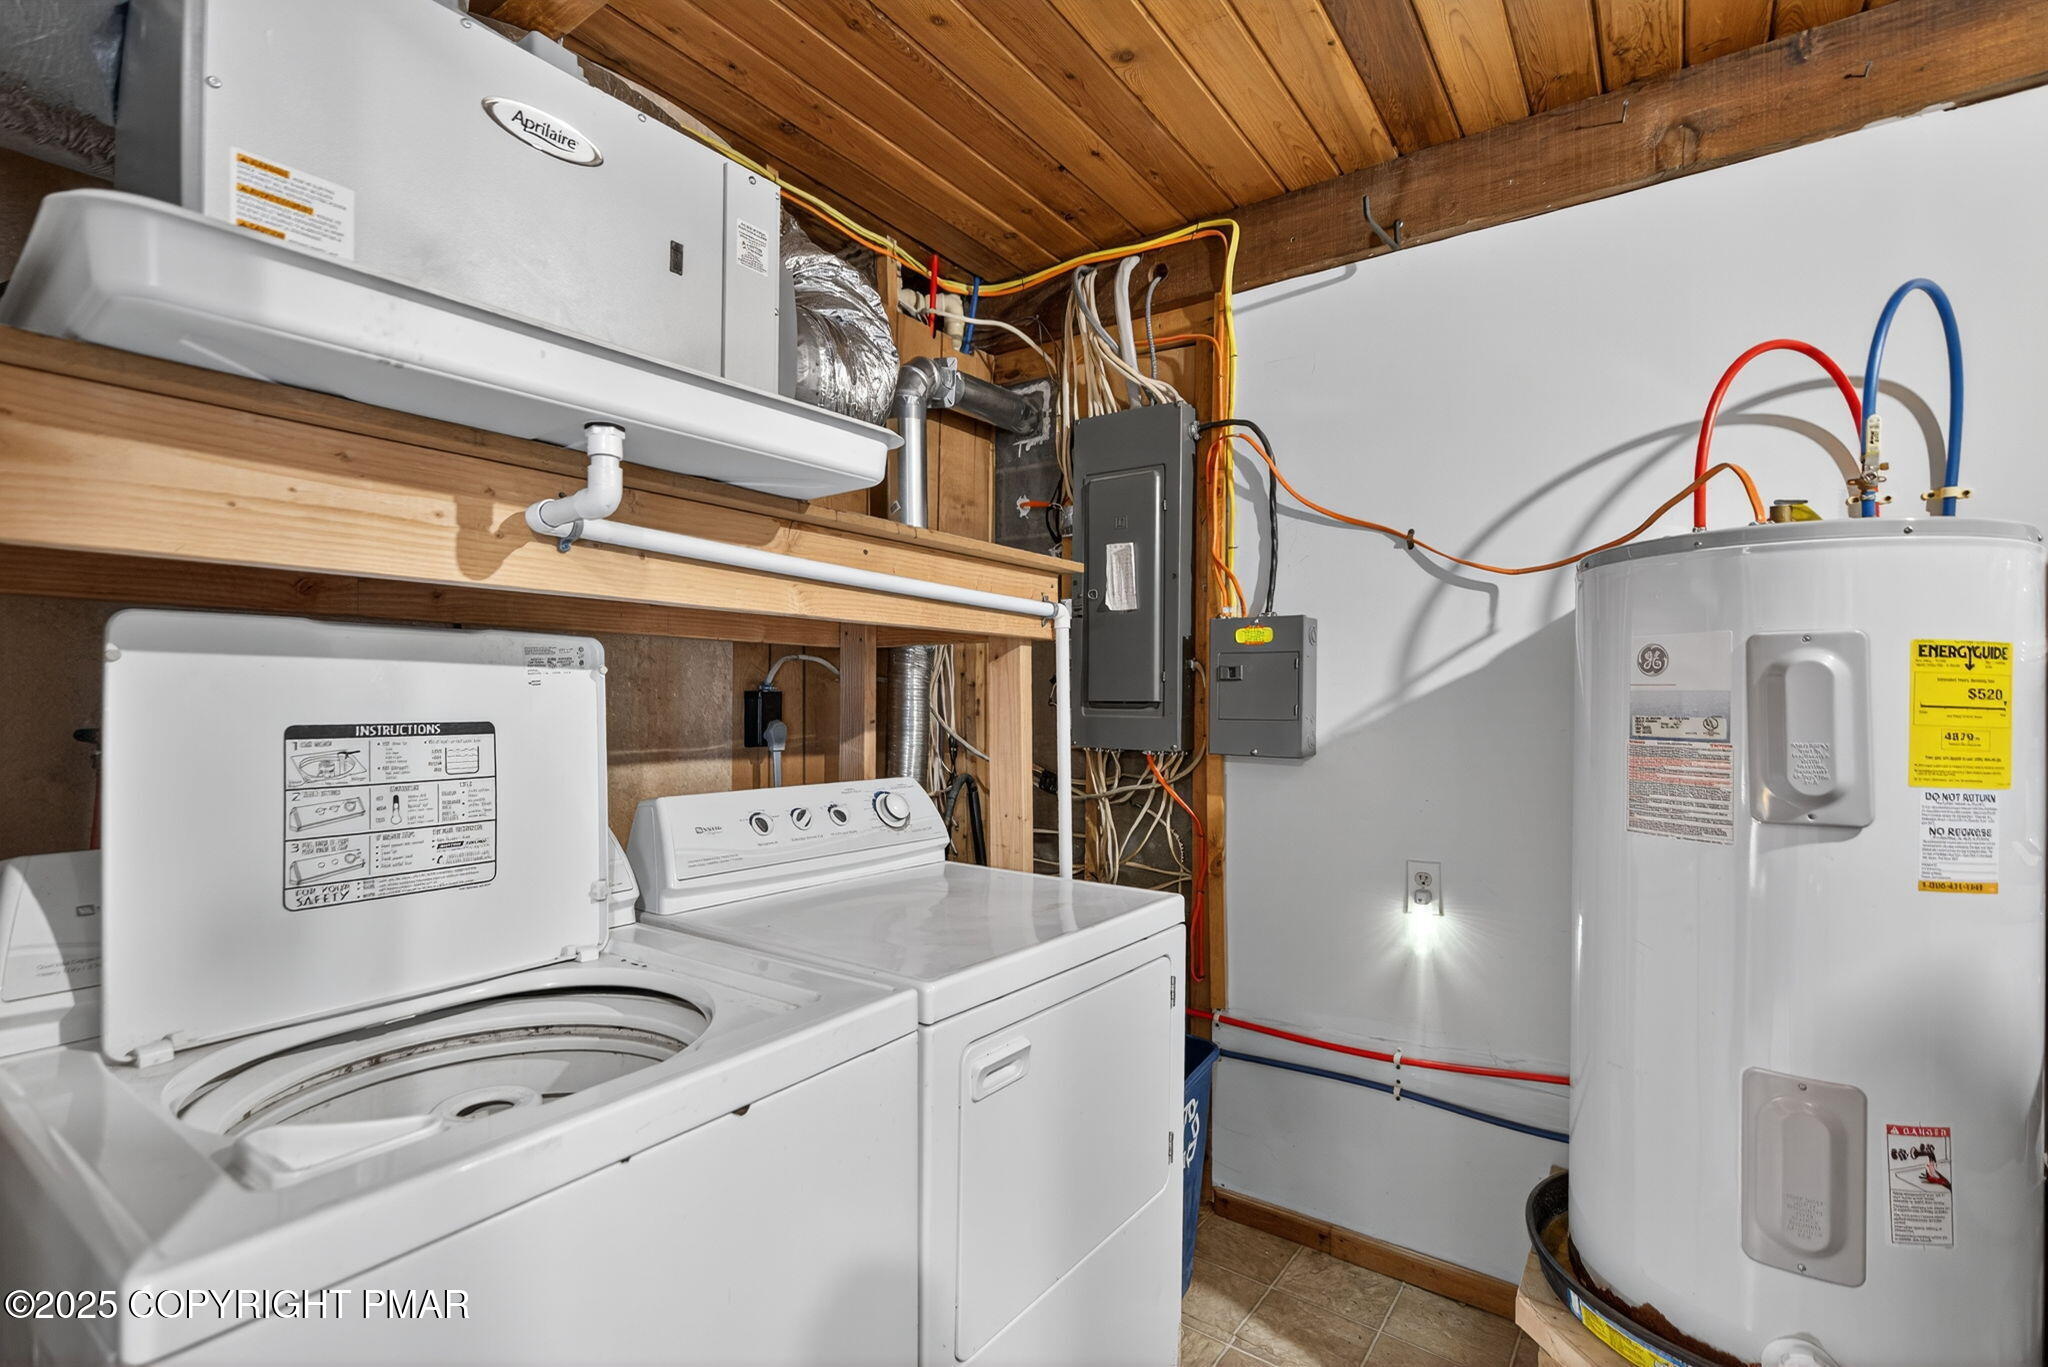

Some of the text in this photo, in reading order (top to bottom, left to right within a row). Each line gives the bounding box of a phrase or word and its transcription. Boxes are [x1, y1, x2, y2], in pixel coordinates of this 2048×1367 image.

[511, 109, 577, 150] Aprilaire
[1918, 644, 2008, 661] ENERGYGUIDE
[355, 724, 441, 737] INSTRUCTIONS
[1925, 792, 1940, 802] DO
[1942, 793, 1960, 802] NOT
[1929, 827, 1945, 836] NO
[296, 887, 316, 897] FOR
[296, 890, 350, 908] SAFETY
